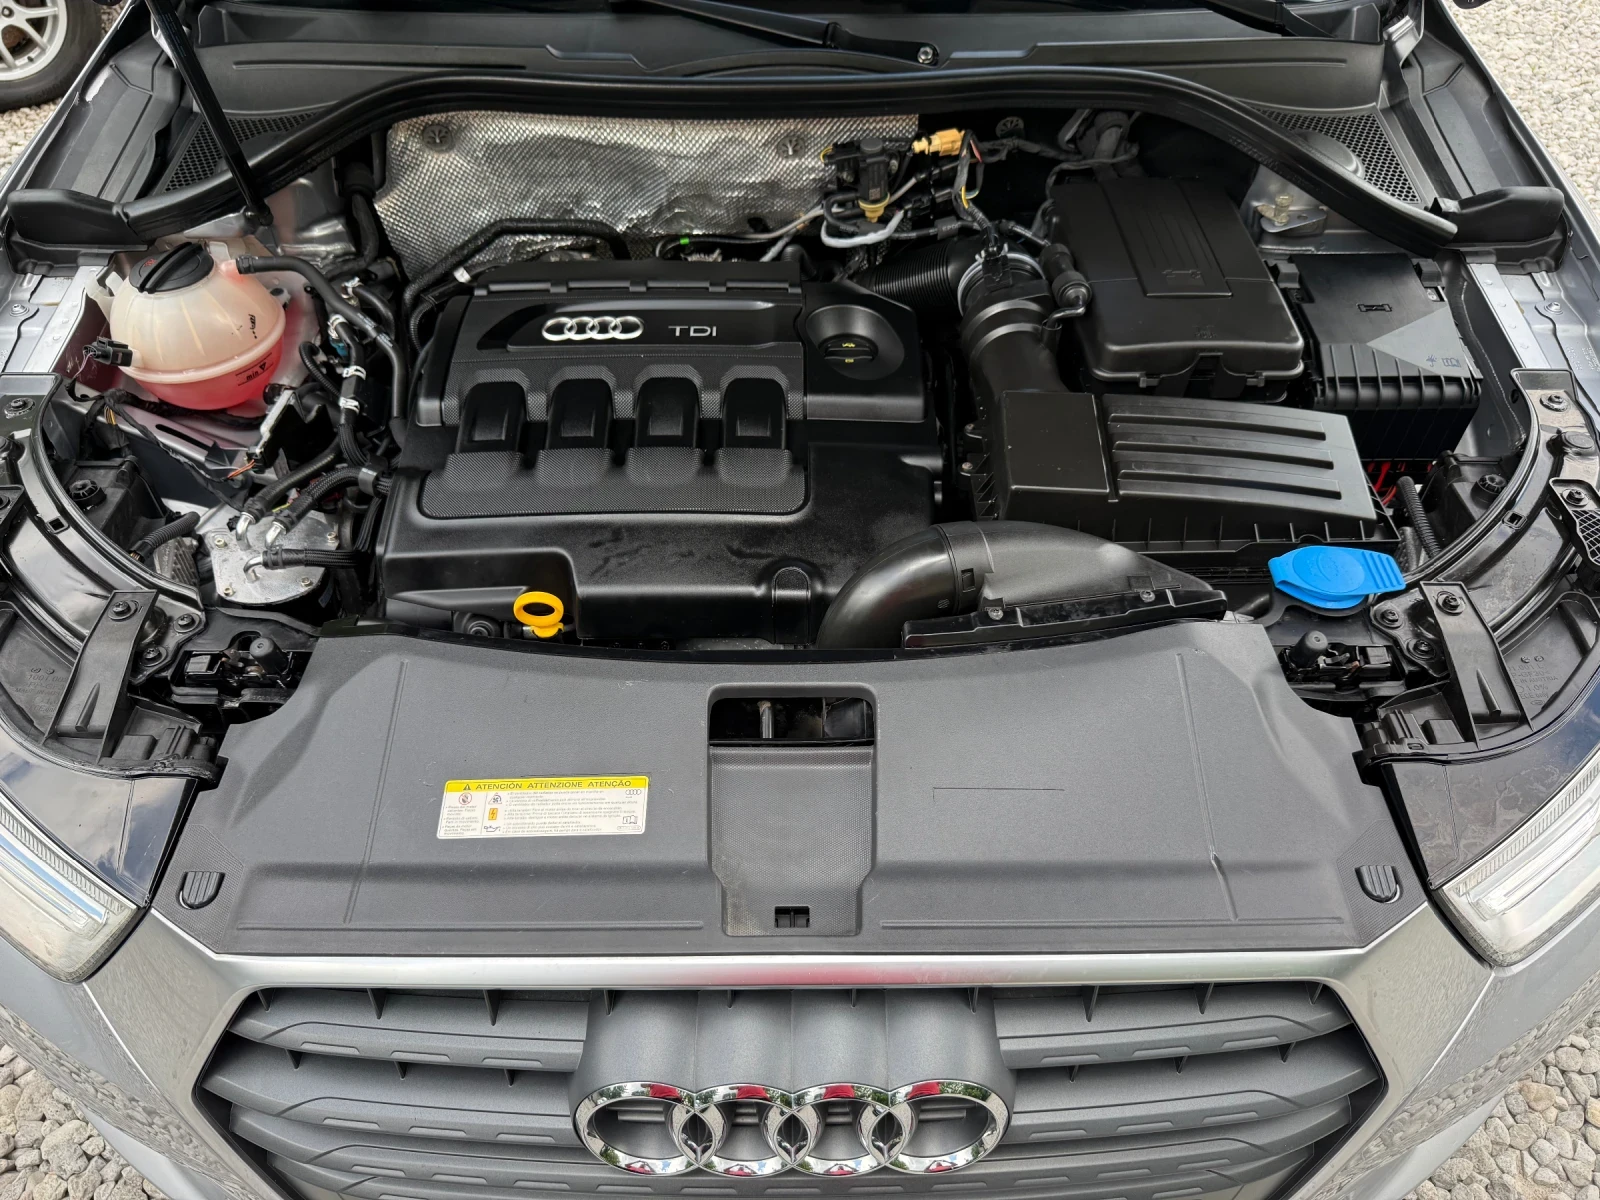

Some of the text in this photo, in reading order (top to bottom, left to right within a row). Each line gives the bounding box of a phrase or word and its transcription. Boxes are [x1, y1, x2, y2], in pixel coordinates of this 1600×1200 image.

[668, 325, 717, 337] TDI
[246, 370, 260, 381] min
[475, 779, 632, 790] ATENCIÓN ATTENZIONE ATENÇÃO
